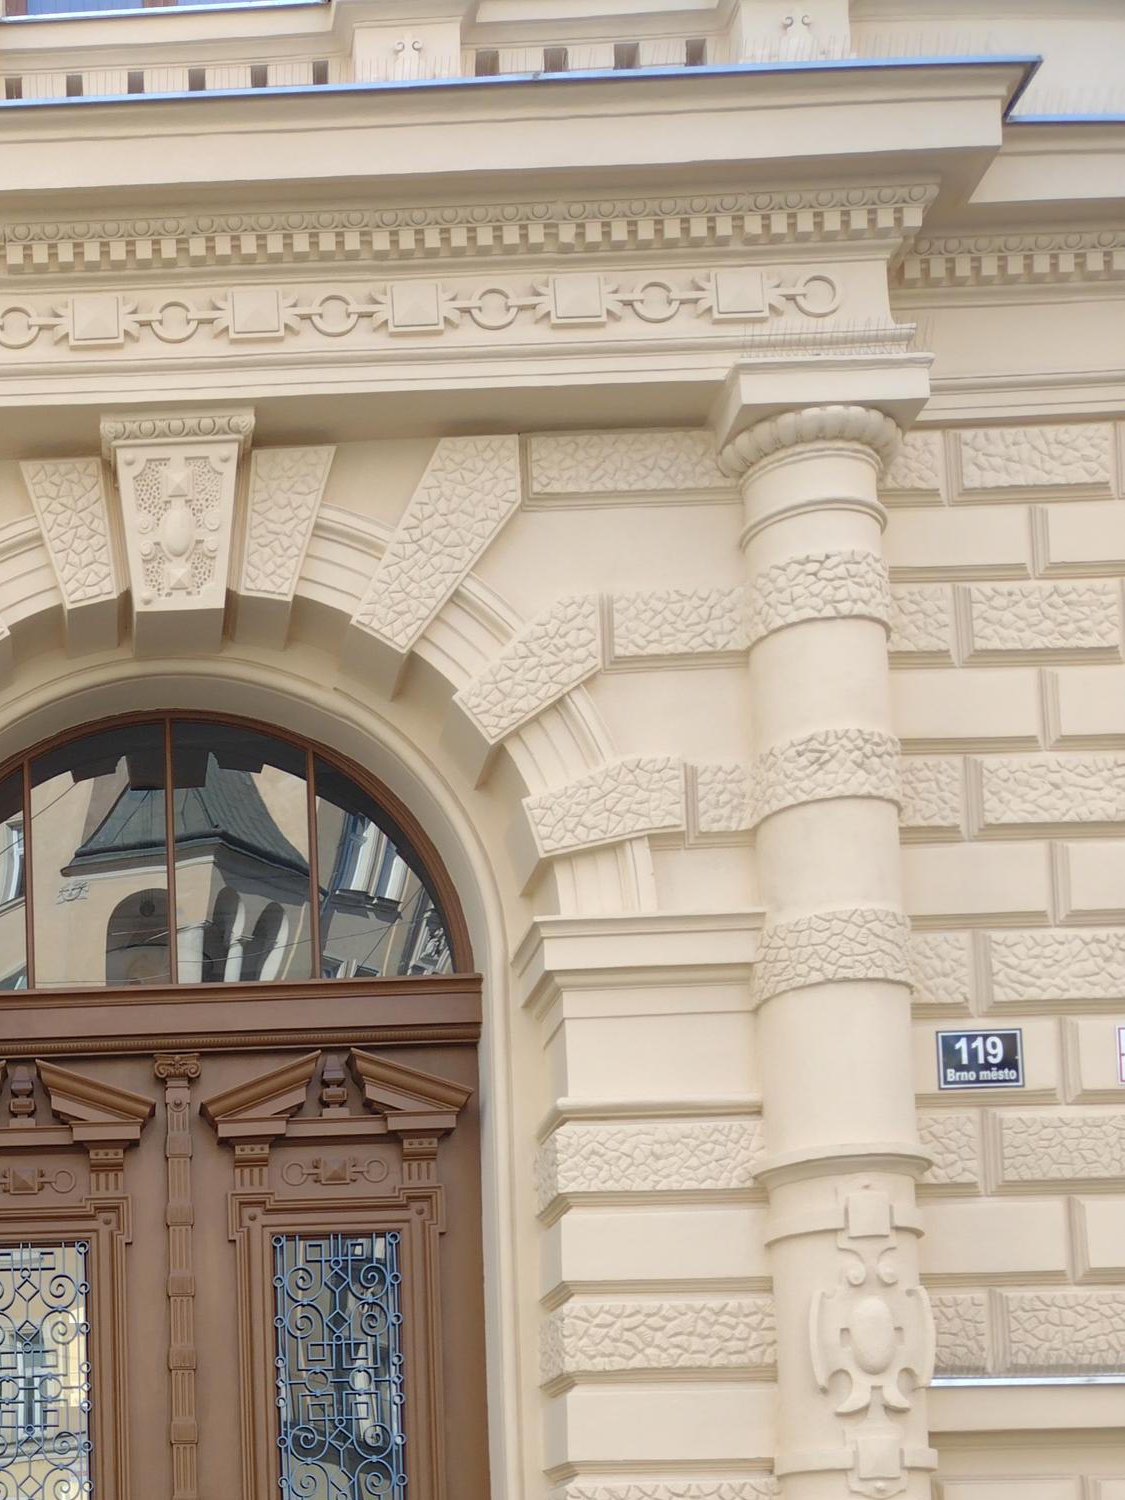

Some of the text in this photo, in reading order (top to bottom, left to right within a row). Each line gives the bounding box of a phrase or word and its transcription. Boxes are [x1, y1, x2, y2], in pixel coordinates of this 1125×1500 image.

[954, 1036, 1004, 1065] 119
[946, 1067, 1017, 1082] Brno město
